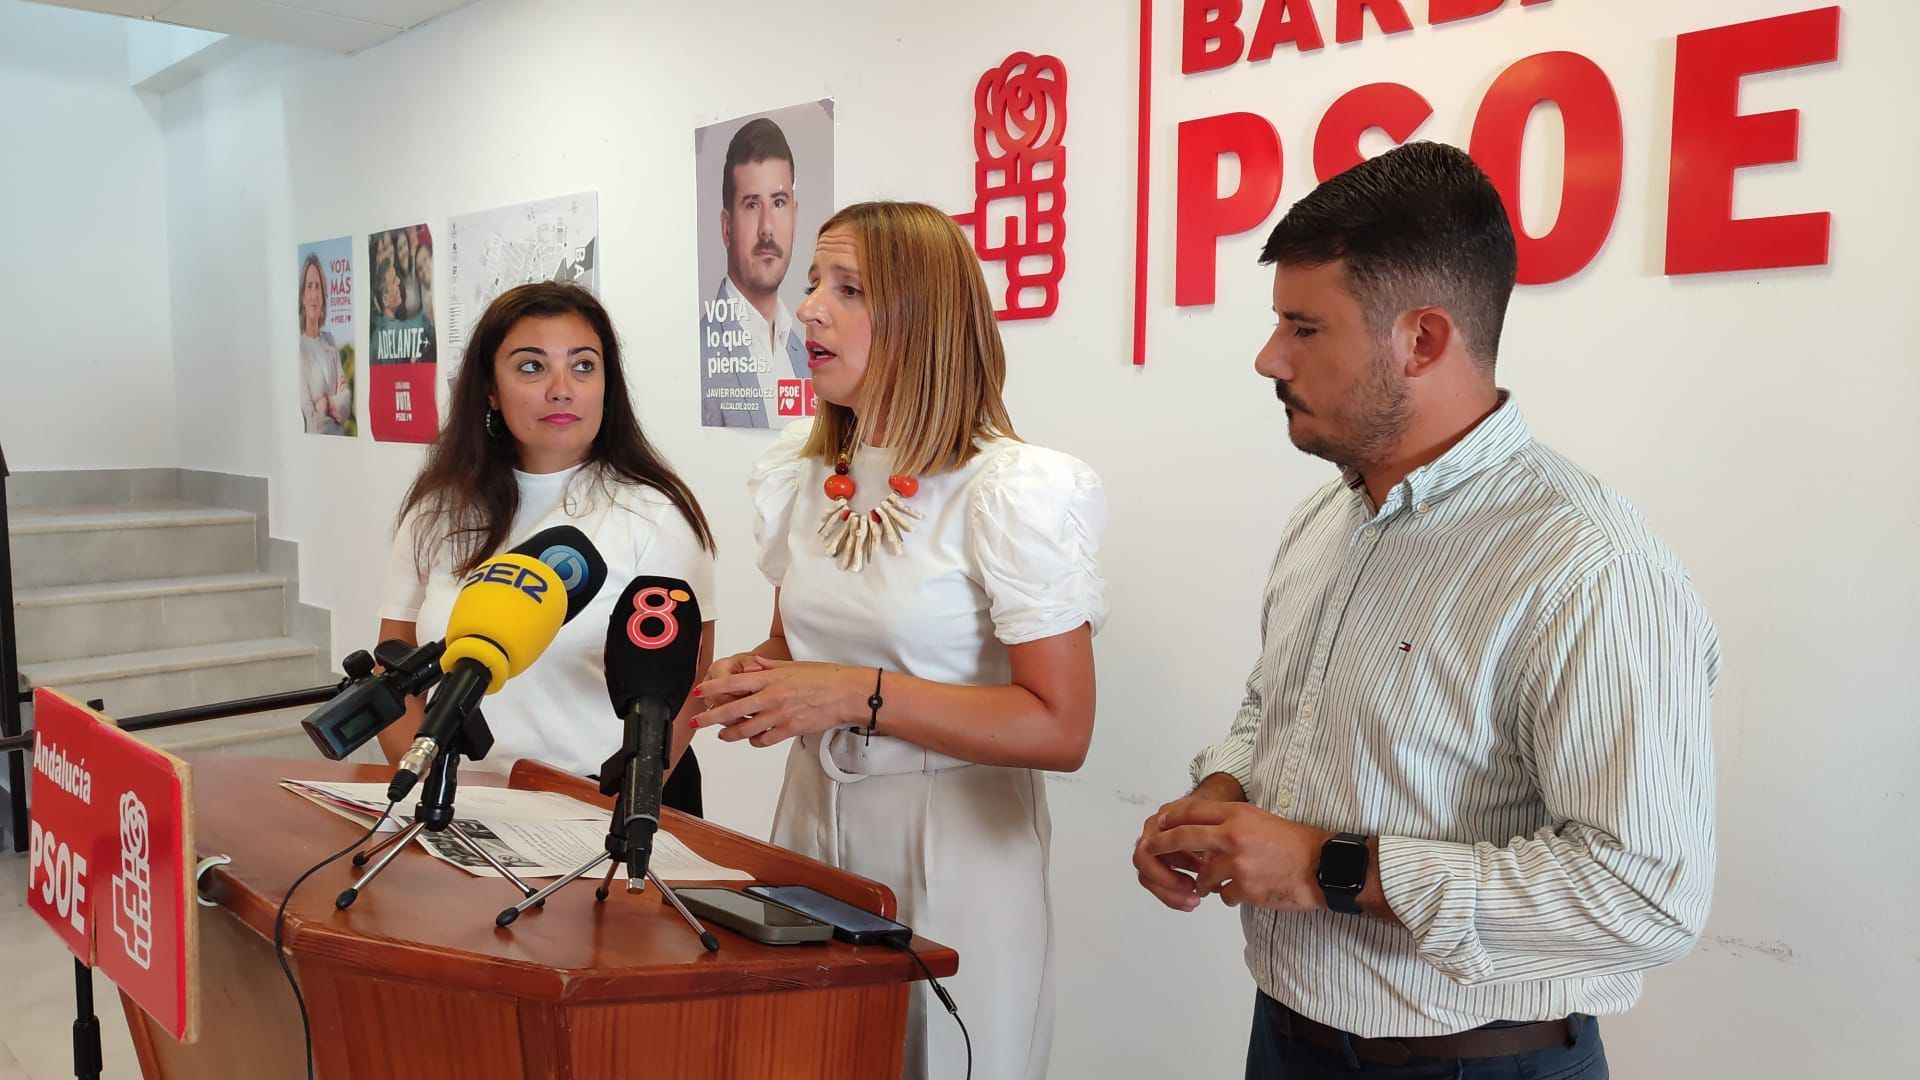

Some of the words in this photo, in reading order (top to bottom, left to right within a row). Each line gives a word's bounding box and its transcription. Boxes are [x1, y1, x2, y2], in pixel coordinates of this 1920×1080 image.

[1182, 0, 1555, 76] BAR
[329, 259, 352, 273] VOTA
[330, 273, 352, 295] MÁS
[704, 298, 750, 323] VOTA
[707, 326, 720, 348] lo
[722, 330, 753, 352] que
[707, 352, 773, 378] piensas.
[395, 391, 412, 411] VOTA
[706, 388, 730, 398] JAVIER
[730, 385, 775, 398] RODRÍGUEZ
[779, 386, 800, 398] PSOE
[720, 402, 743, 410] ALCALDE
[461, 563, 548, 604] SER
[33, 731, 91, 805] Andalucía
[29, 819, 87, 935] PSOE
